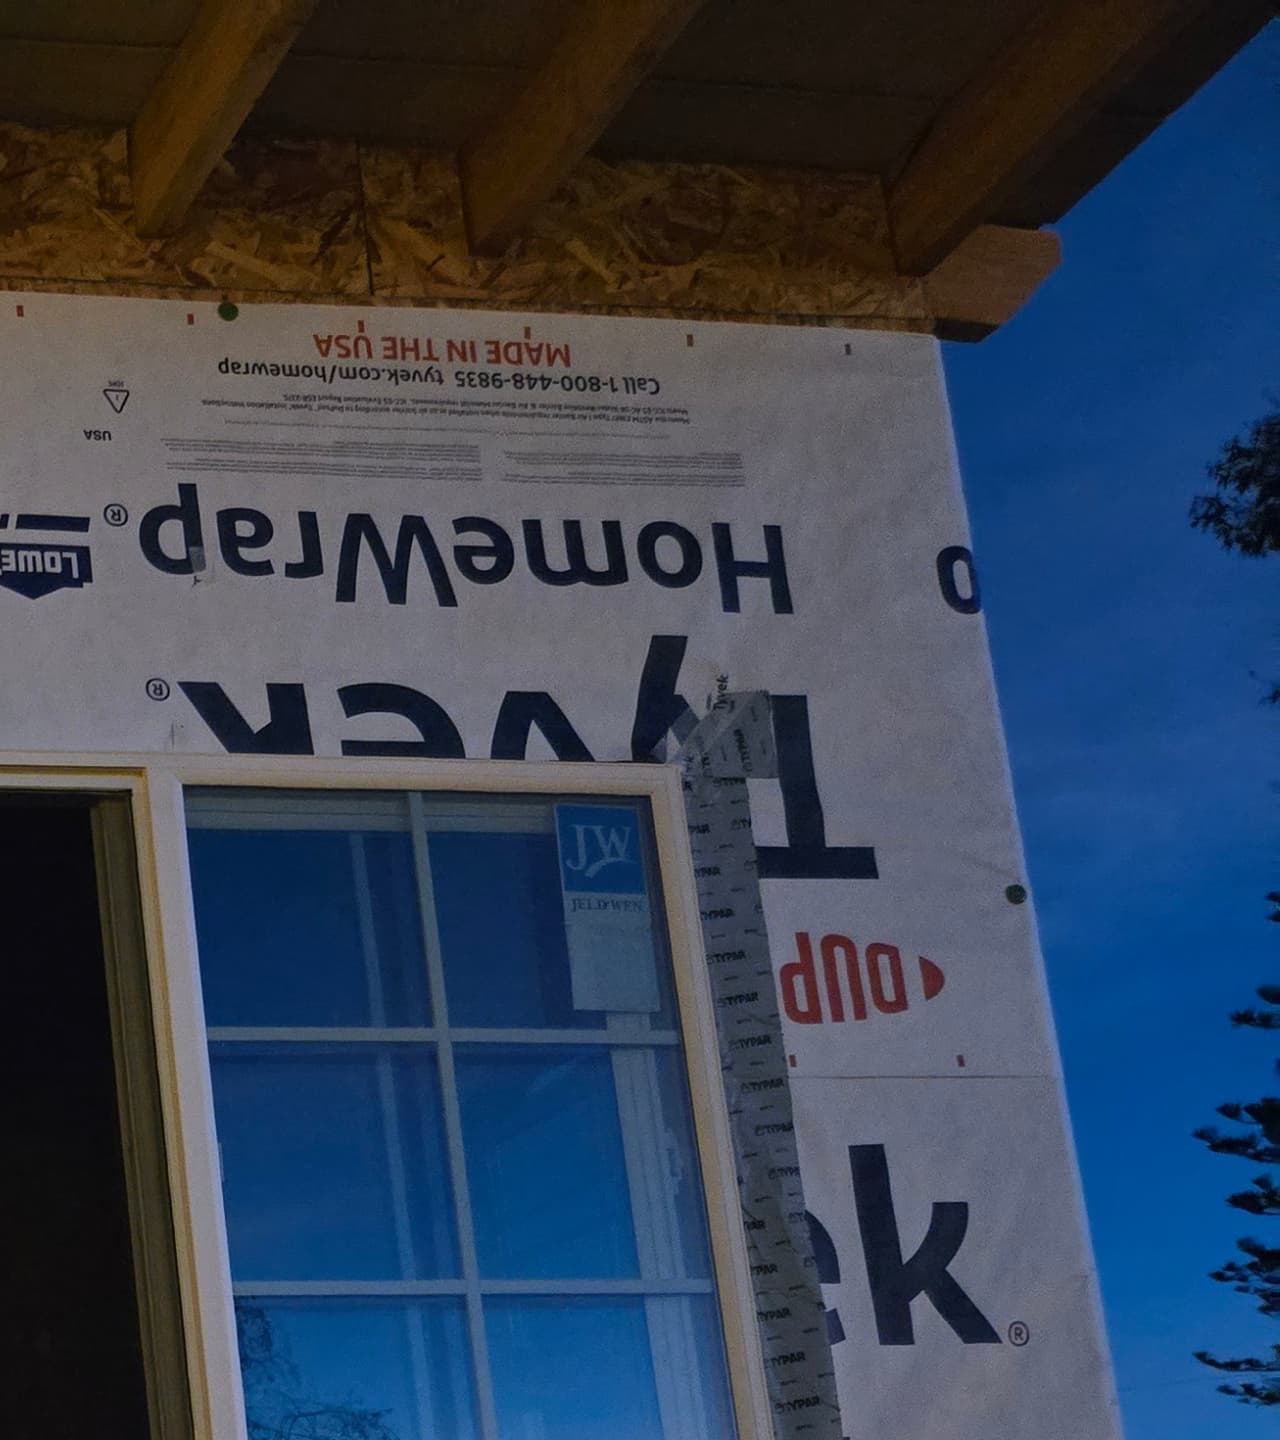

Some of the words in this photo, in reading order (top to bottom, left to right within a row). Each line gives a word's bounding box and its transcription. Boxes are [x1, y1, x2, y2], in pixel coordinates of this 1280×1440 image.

[313, 334, 373, 360] USA
[381, 336, 440, 362] THE
[446, 340, 477, 363] IN
[484, 341, 571, 368] MADE
[218, 358, 443, 385] tyvek.com/homewrap
[454, 370, 618, 393] 1-800-448-9835
[622, 376, 660, 396] Call
[83, 430, 112, 440] USA
[566, 824, 632, 870] JW
[780, 932, 908, 1024] DUP
